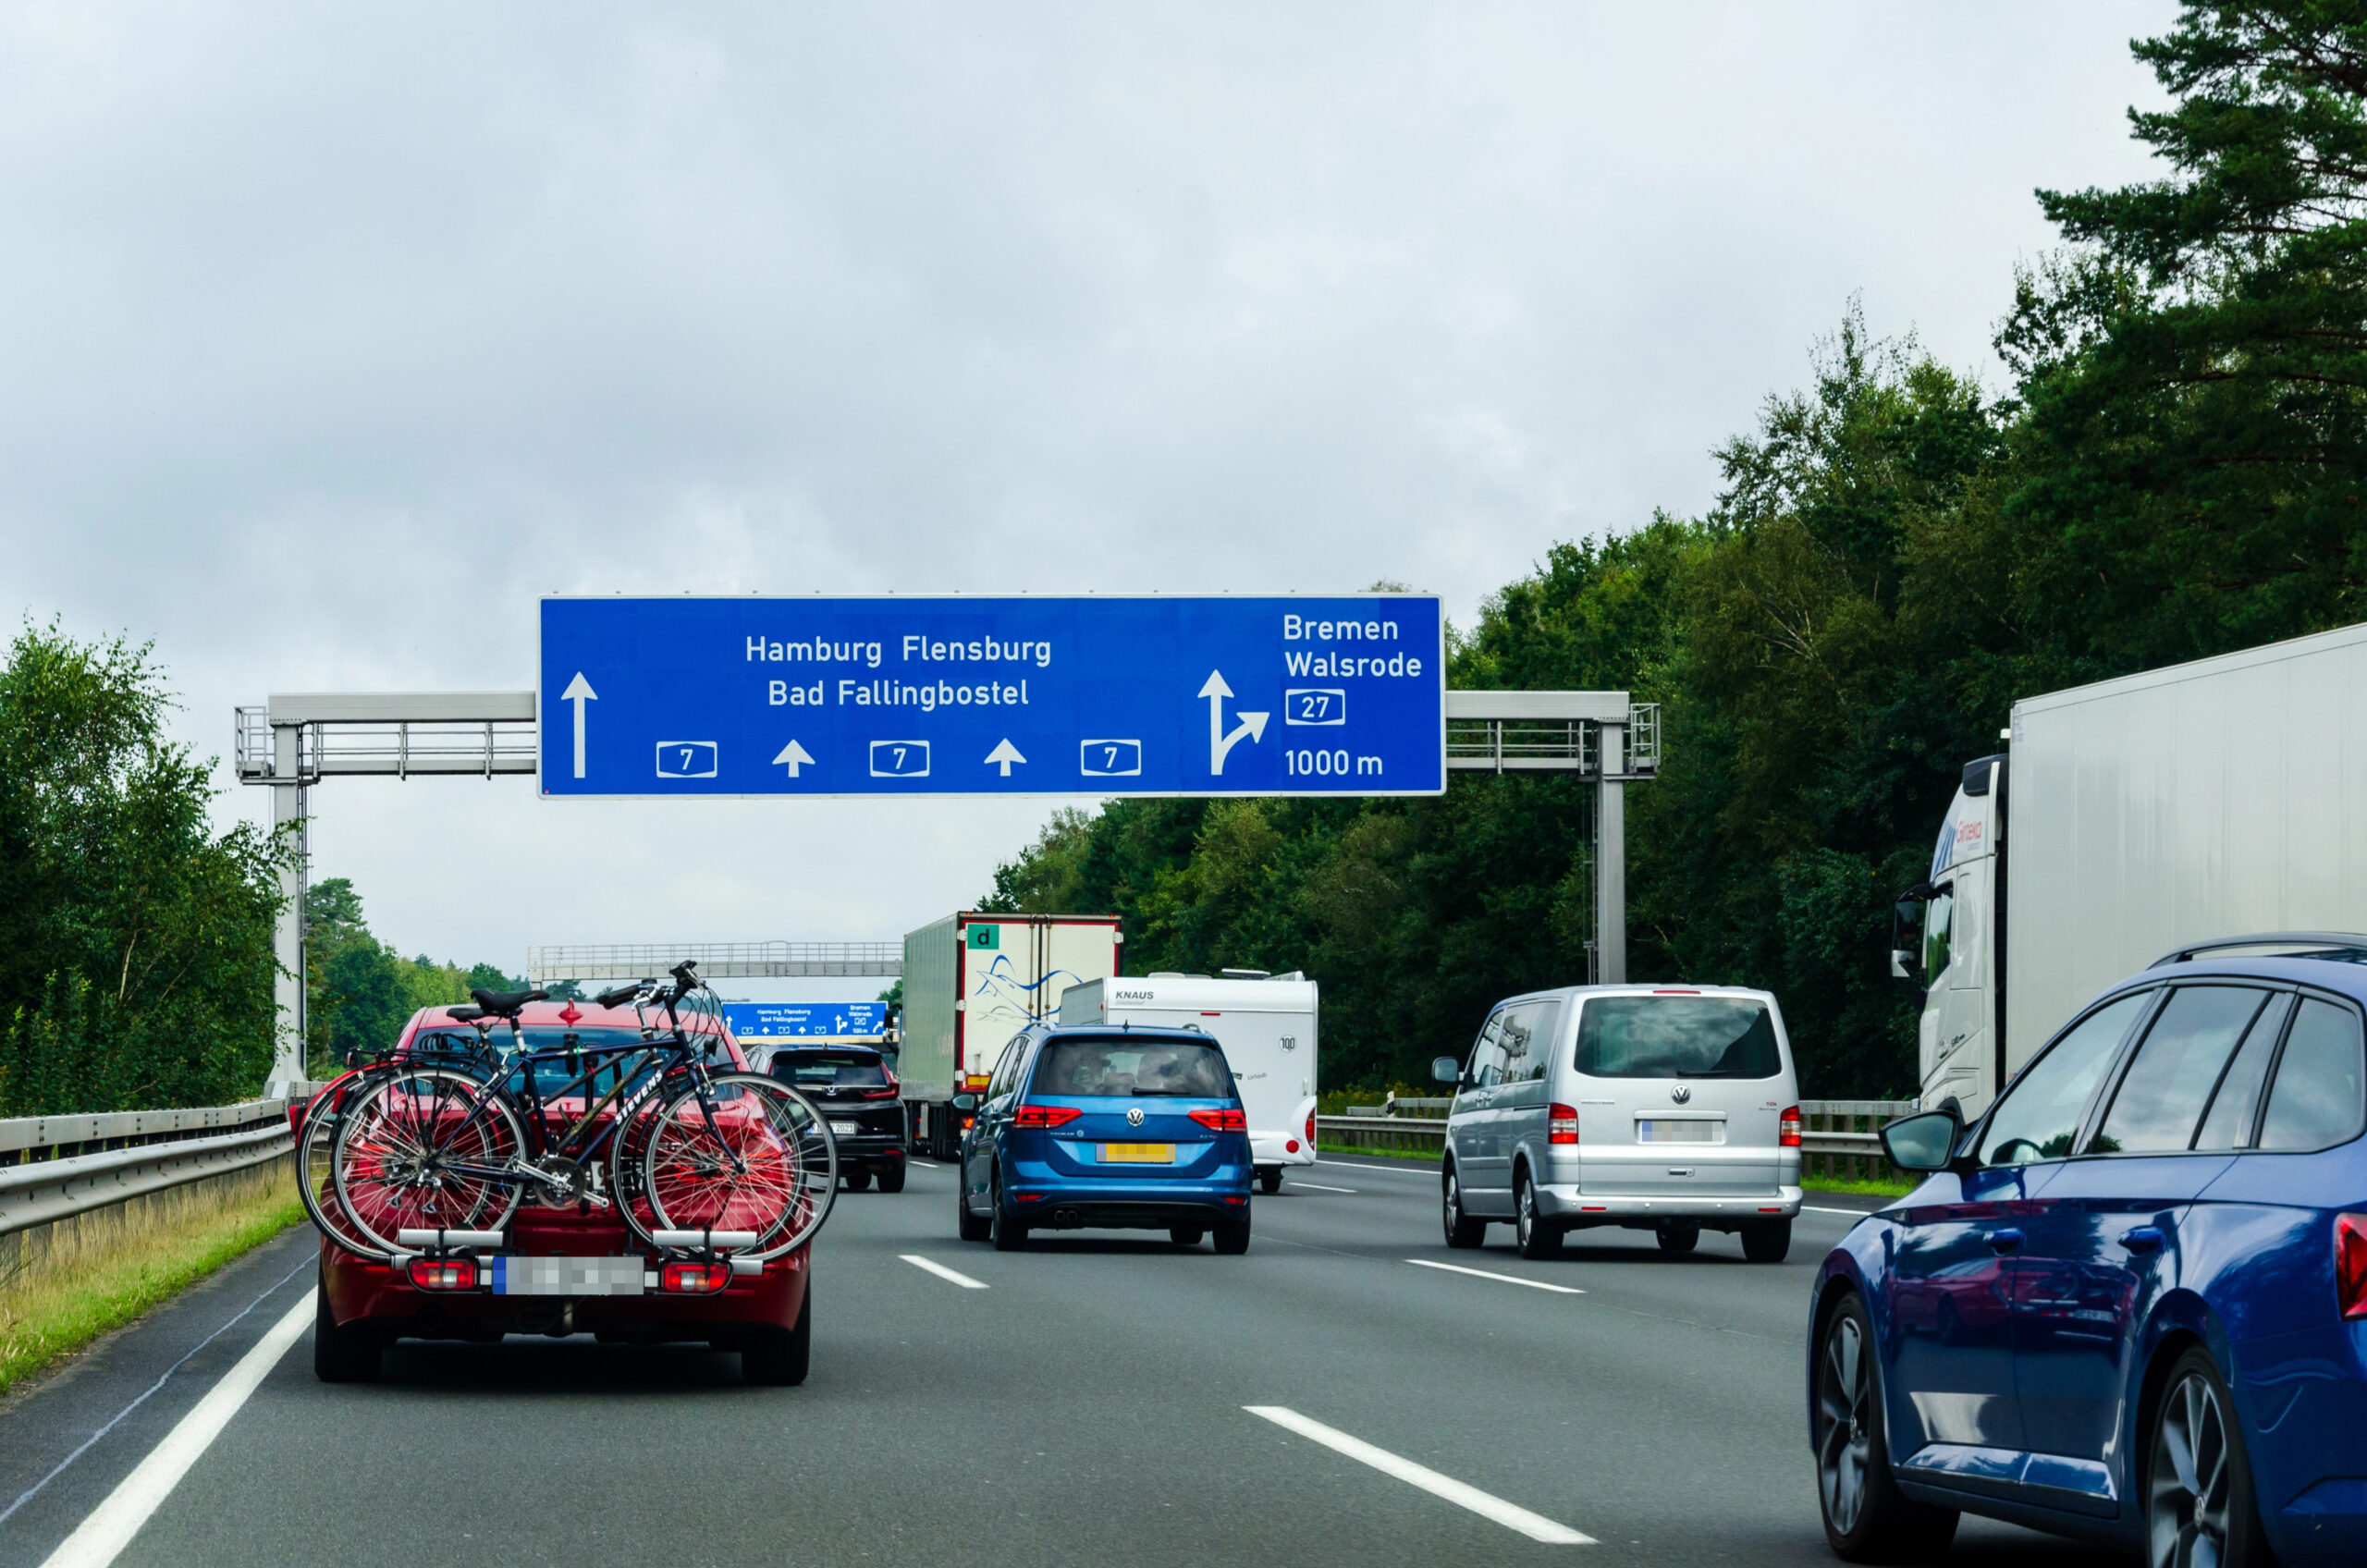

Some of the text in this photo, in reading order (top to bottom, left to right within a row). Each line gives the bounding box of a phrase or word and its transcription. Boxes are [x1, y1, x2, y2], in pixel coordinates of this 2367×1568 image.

[1283, 614, 1398, 640] Bremen
[746, 635, 1050, 668] Hamburg Flensburg
[1284, 651, 1422, 677] Walsrode
[769, 680, 1029, 711] Bad Fallingbostel
[1302, 696, 1330, 717] 27
[680, 749, 693, 770] 7
[893, 748, 906, 769] 7
[1104, 747, 1118, 768] 7
[1285, 750, 1382, 776] 1000 m
[977, 928, 989, 946] d
[1115, 990, 1154, 999] KNAUS
[1281, 1037, 1295, 1049] 100
[615, 1069, 663, 1126] STEVENS
[836, 1123, 853, 1133] 2021
